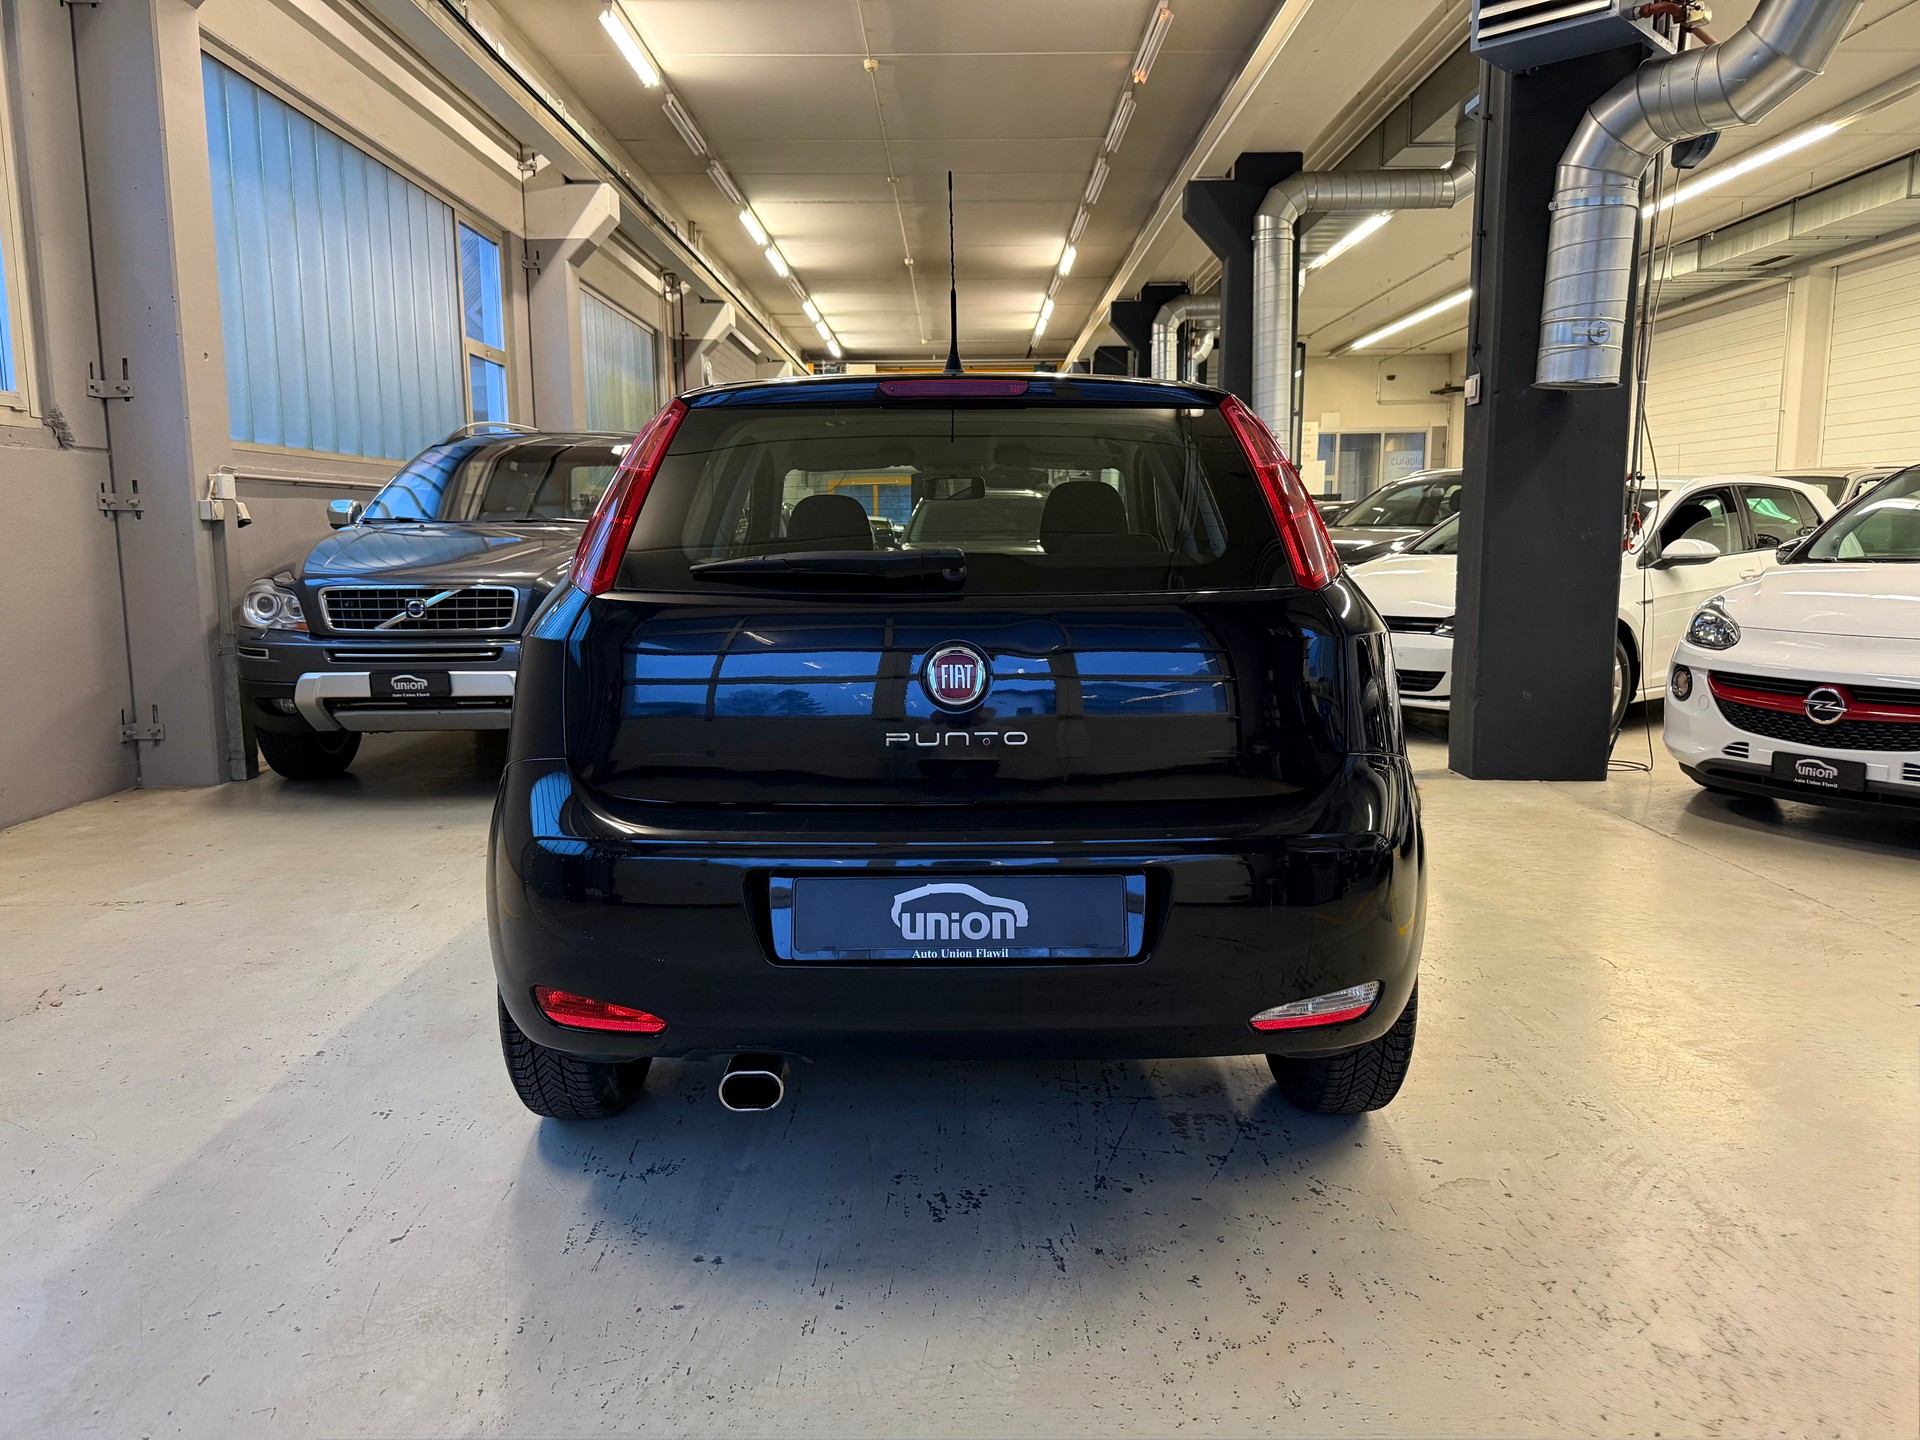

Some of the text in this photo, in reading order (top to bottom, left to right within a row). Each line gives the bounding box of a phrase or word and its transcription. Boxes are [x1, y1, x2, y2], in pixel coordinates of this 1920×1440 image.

[941, 664, 974, 689] FIAT
[394, 682, 424, 690] union
[885, 731, 1029, 747] PUNTO
[1798, 766, 1833, 779] union
[901, 911, 1015, 940] union
[912, 948, 1009, 959] Auto Union Flawil
